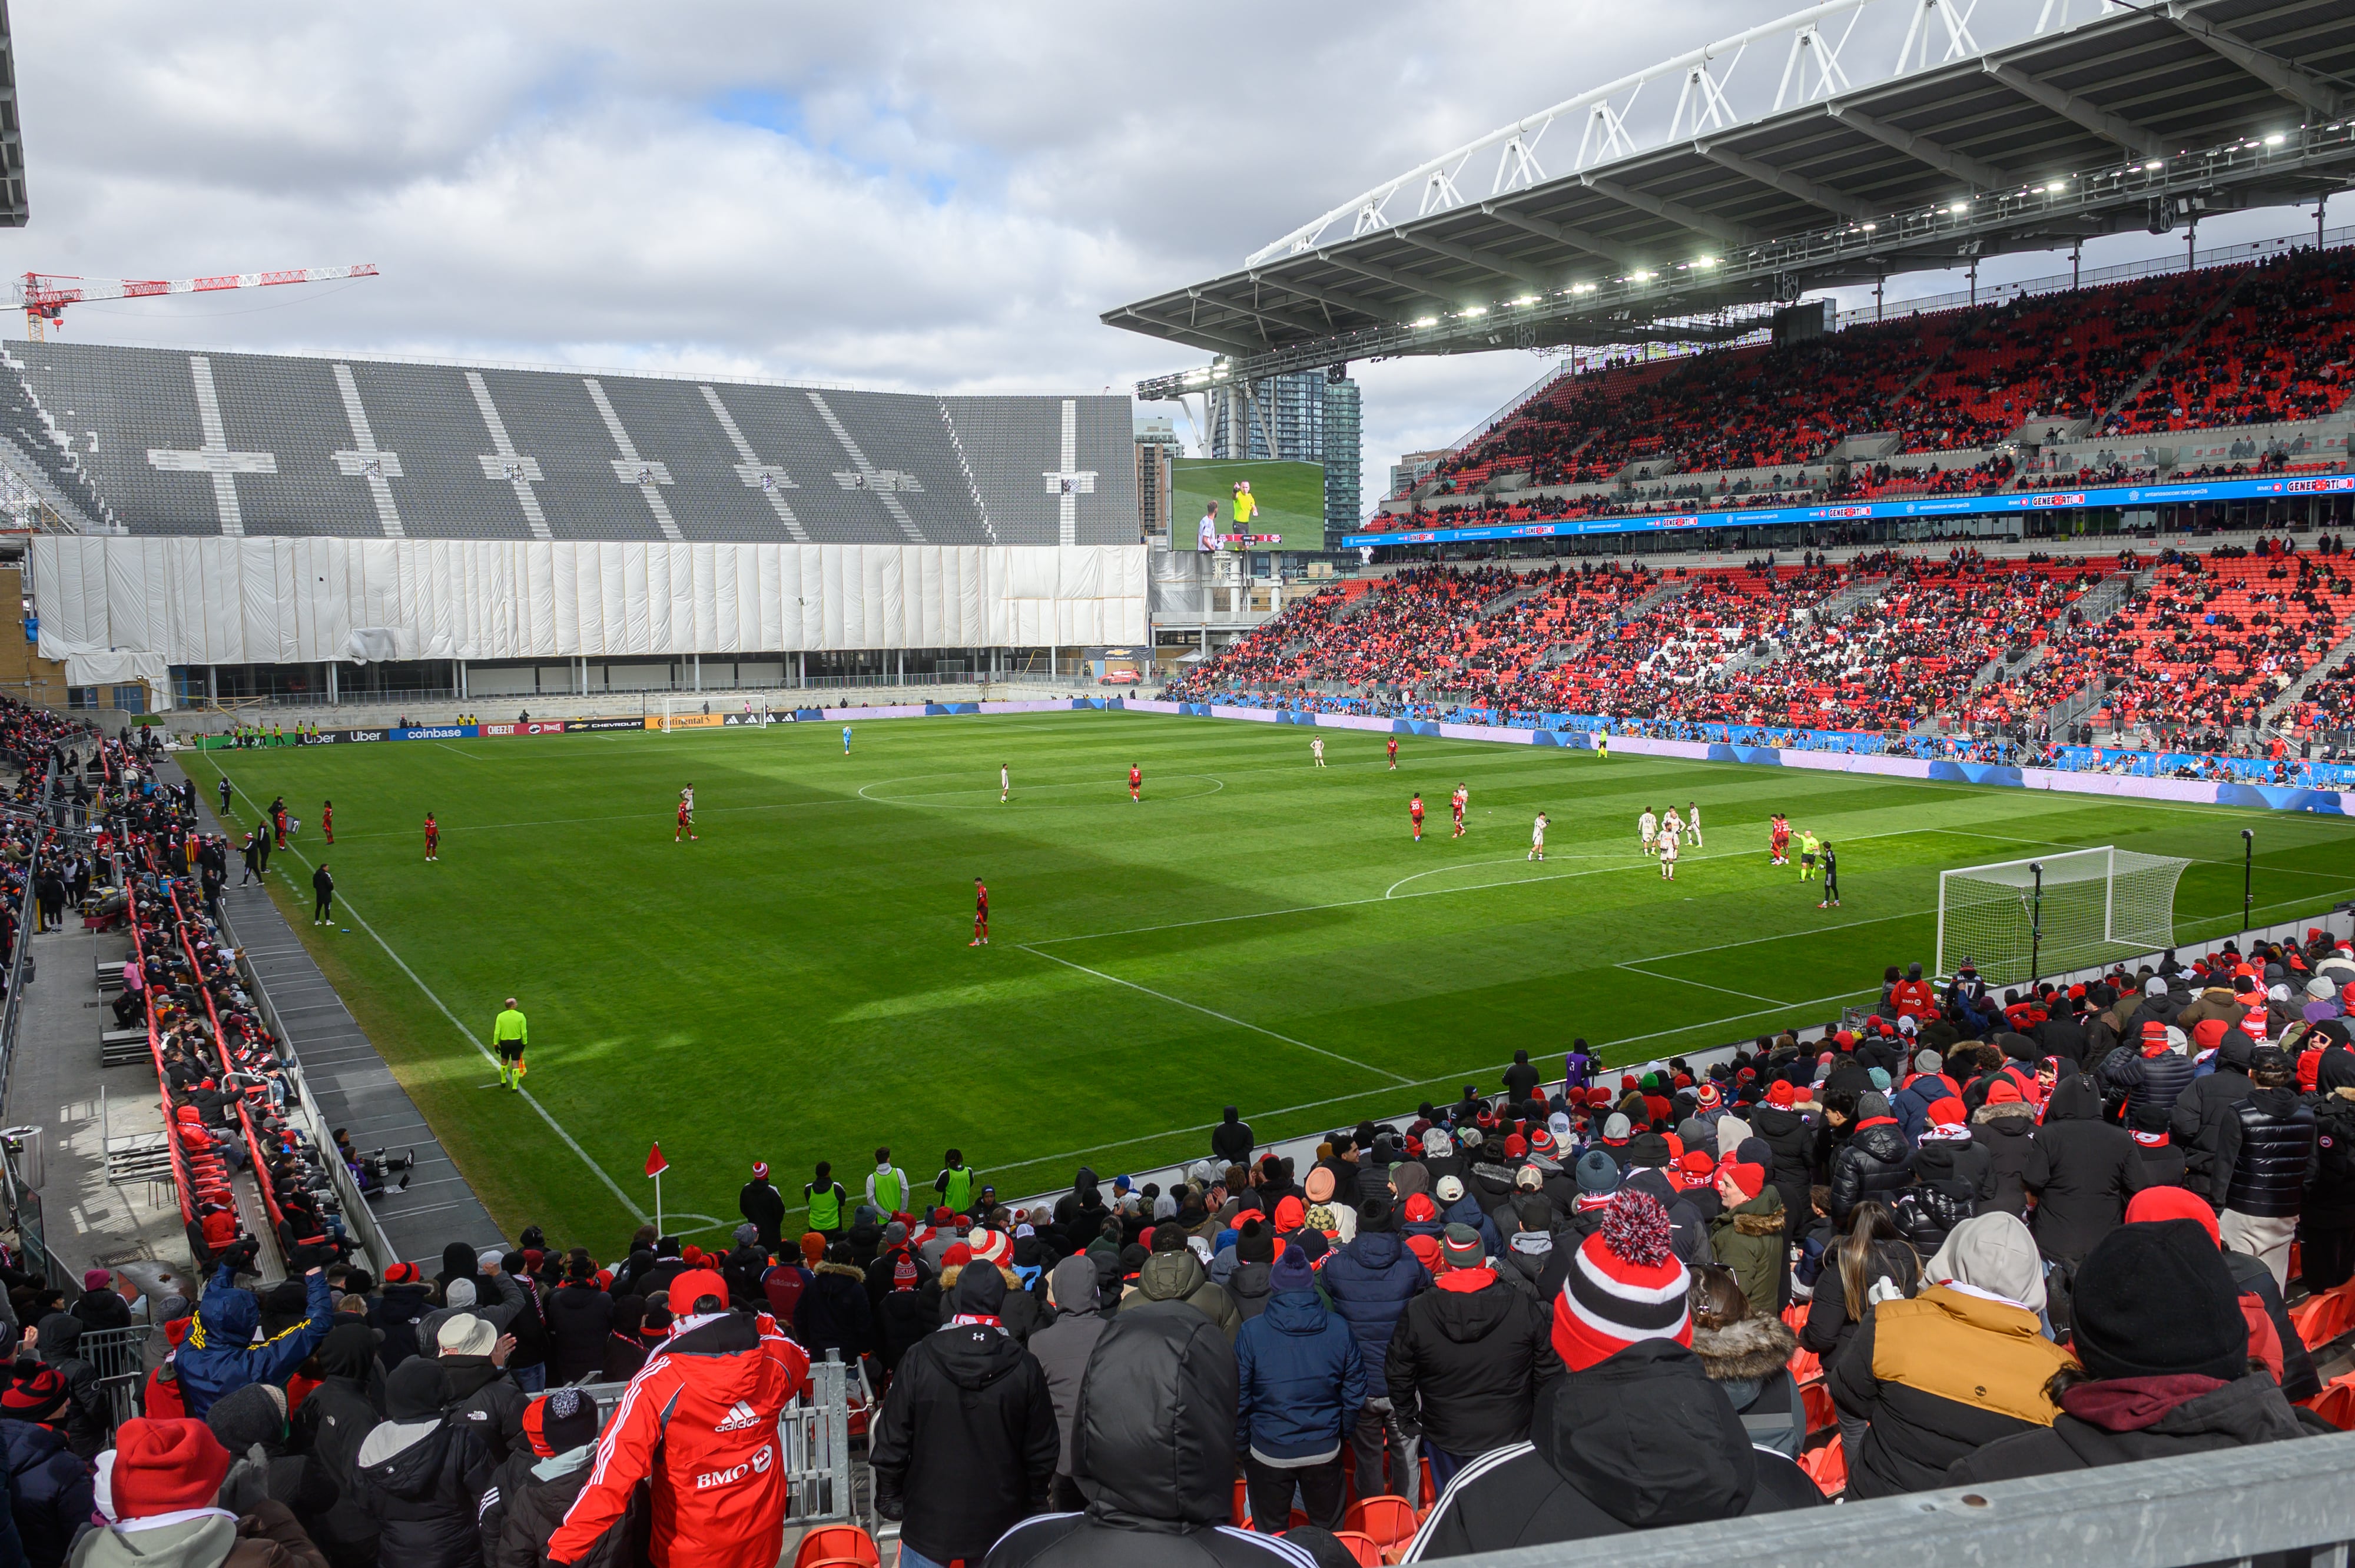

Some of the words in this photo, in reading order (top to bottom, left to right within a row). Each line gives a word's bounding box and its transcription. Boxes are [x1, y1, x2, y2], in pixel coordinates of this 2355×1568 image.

[2144, 489, 2208, 497] ontariosoccer.net/gen26
[543, 723, 560, 732] PRINGLES
[350, 731, 382, 742] Uber
[407, 728, 462, 739] coinbase
[715, 1415, 761, 1433] adidas
[696, 1463, 748, 1490] BMO
